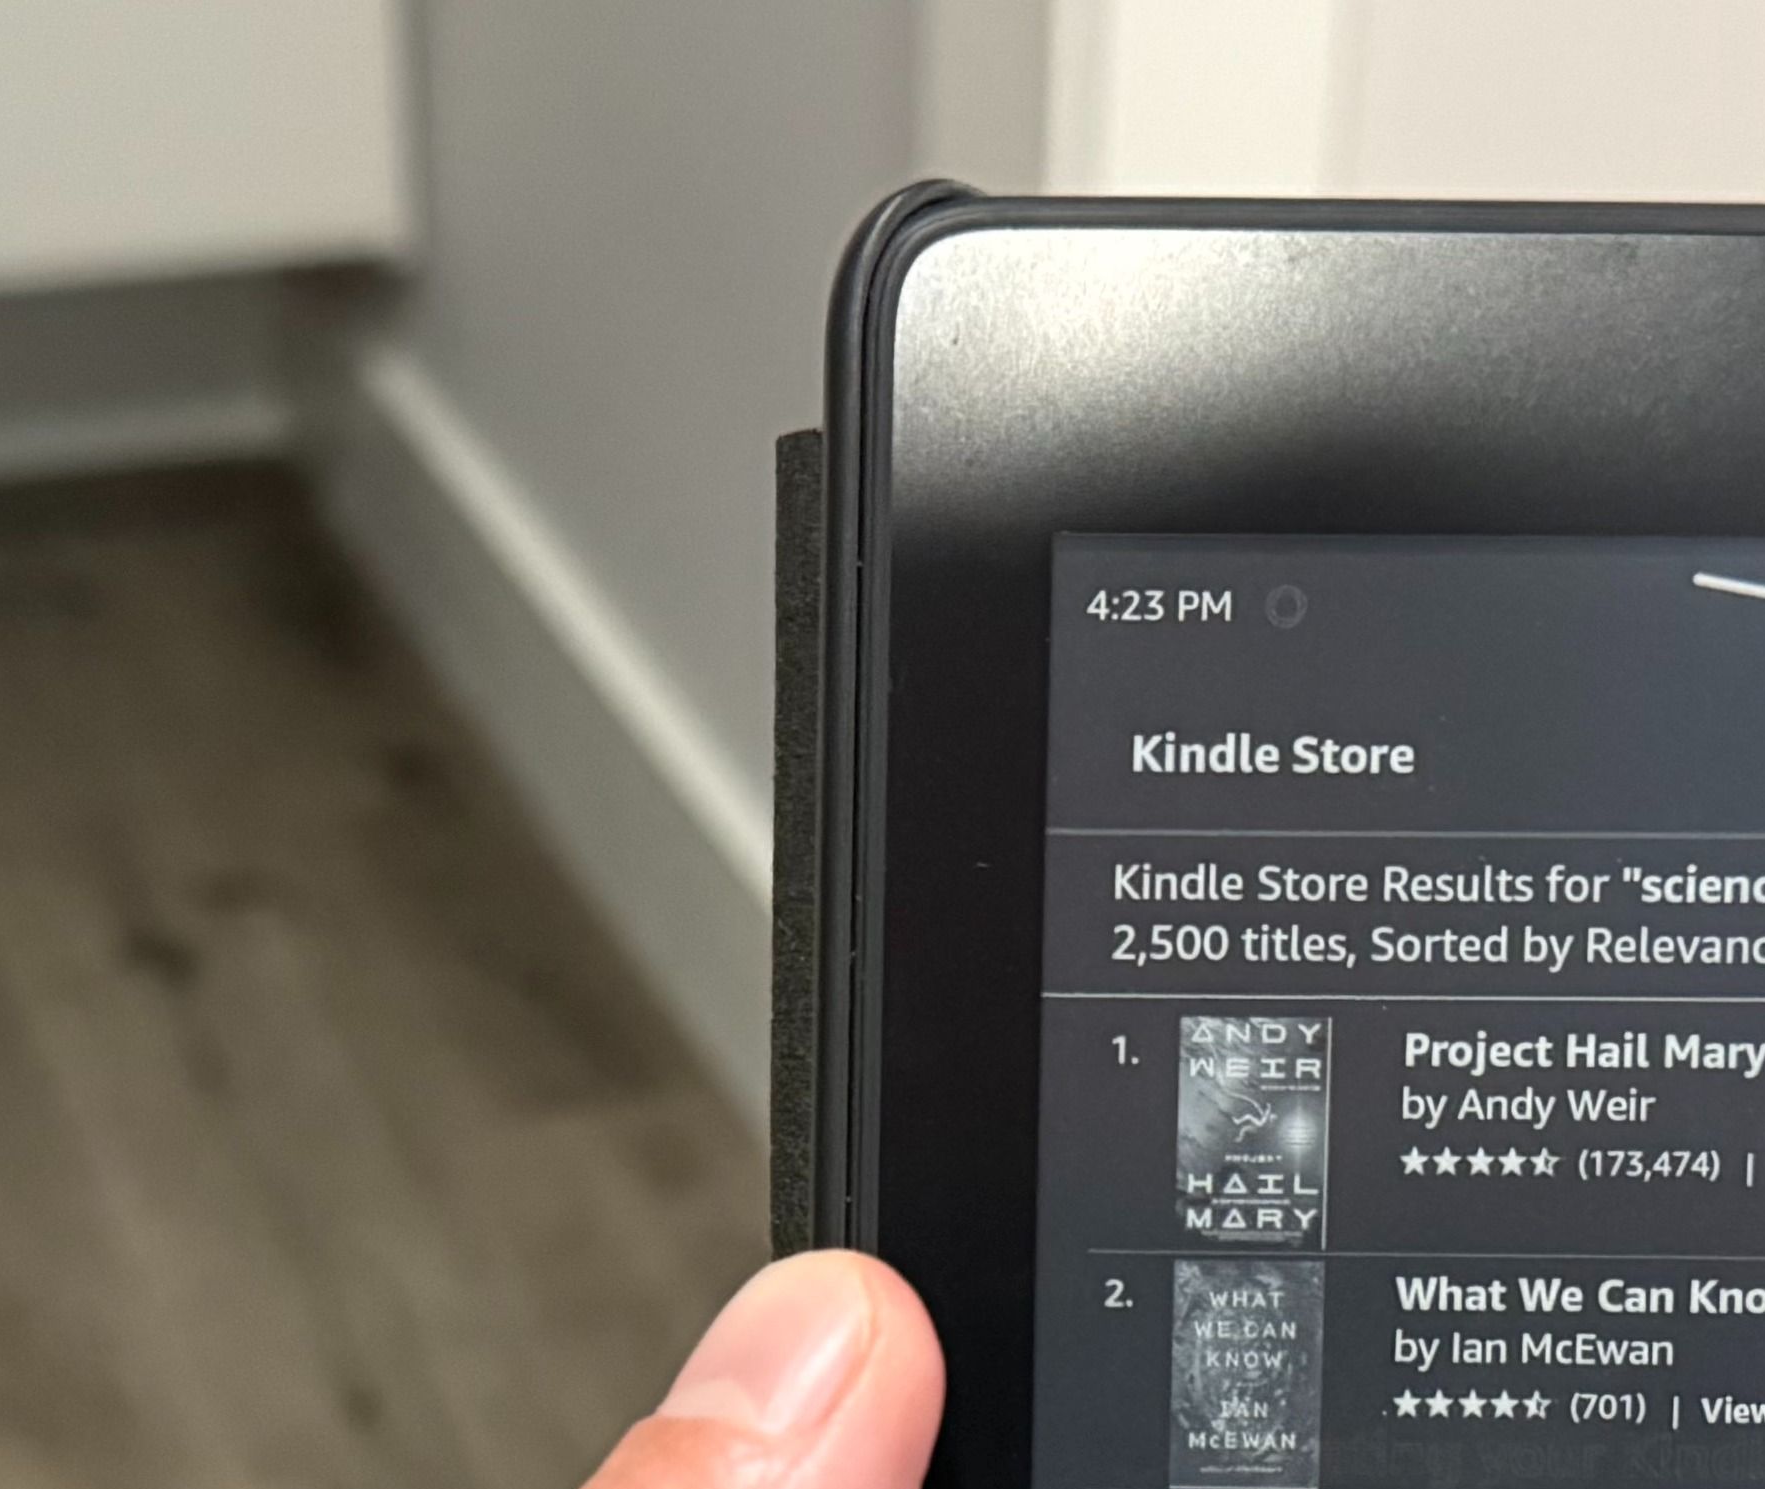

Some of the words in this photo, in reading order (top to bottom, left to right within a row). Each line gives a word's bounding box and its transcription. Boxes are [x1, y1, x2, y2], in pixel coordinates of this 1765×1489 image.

[1086, 589, 1165, 621] 4:23
[1177, 590, 1232, 622] PM
[1132, 731, 1280, 774] Kindle
[1292, 735, 1415, 774] Store
[1114, 862, 1244, 901] Kindle
[1257, 865, 1369, 902] Store
[1383, 864, 1534, 903] Results
[1545, 864, 1611, 903] for
[1111, 924, 1230, 967] 2,500
[1240, 923, 1356, 969] titles,
[1370, 925, 1509, 963] Sorted
[1523, 925, 1575, 974] by
[1191, 1022, 1322, 1044] ANDY
[1112, 1035, 1139, 1065] 1.
[1405, 1030, 1554, 1077] Project
[1566, 1031, 1650, 1069] Hail
[1189, 1057, 1321, 1079] WEIR
[1402, 1085, 1448, 1130] by
[1457, 1086, 1557, 1130] Andy
[1566, 1087, 1657, 1122] Weir
[1578, 1148, 1721, 1183] (173,474)
[1186, 1172, 1320, 1195] HAIL
[1185, 1207, 1319, 1230] MARY
[1104, 1278, 1134, 1308] 2.
[1208, 1290, 1285, 1309] WHAT
[1395, 1275, 1507, 1312] What
[1518, 1277, 1584, 1313] We
[1597, 1278, 1675, 1314] Can
[1193, 1320, 1233, 1339] WE
[1243, 1321, 1297, 1339] CAN
[1205, 1350, 1284, 1369] KNOW
[1394, 1328, 1441, 1373] by
[1452, 1331, 1507, 1364] Ian
[1521, 1332, 1674, 1366] McEwan
[1570, 1392, 1646, 1424] (701)
